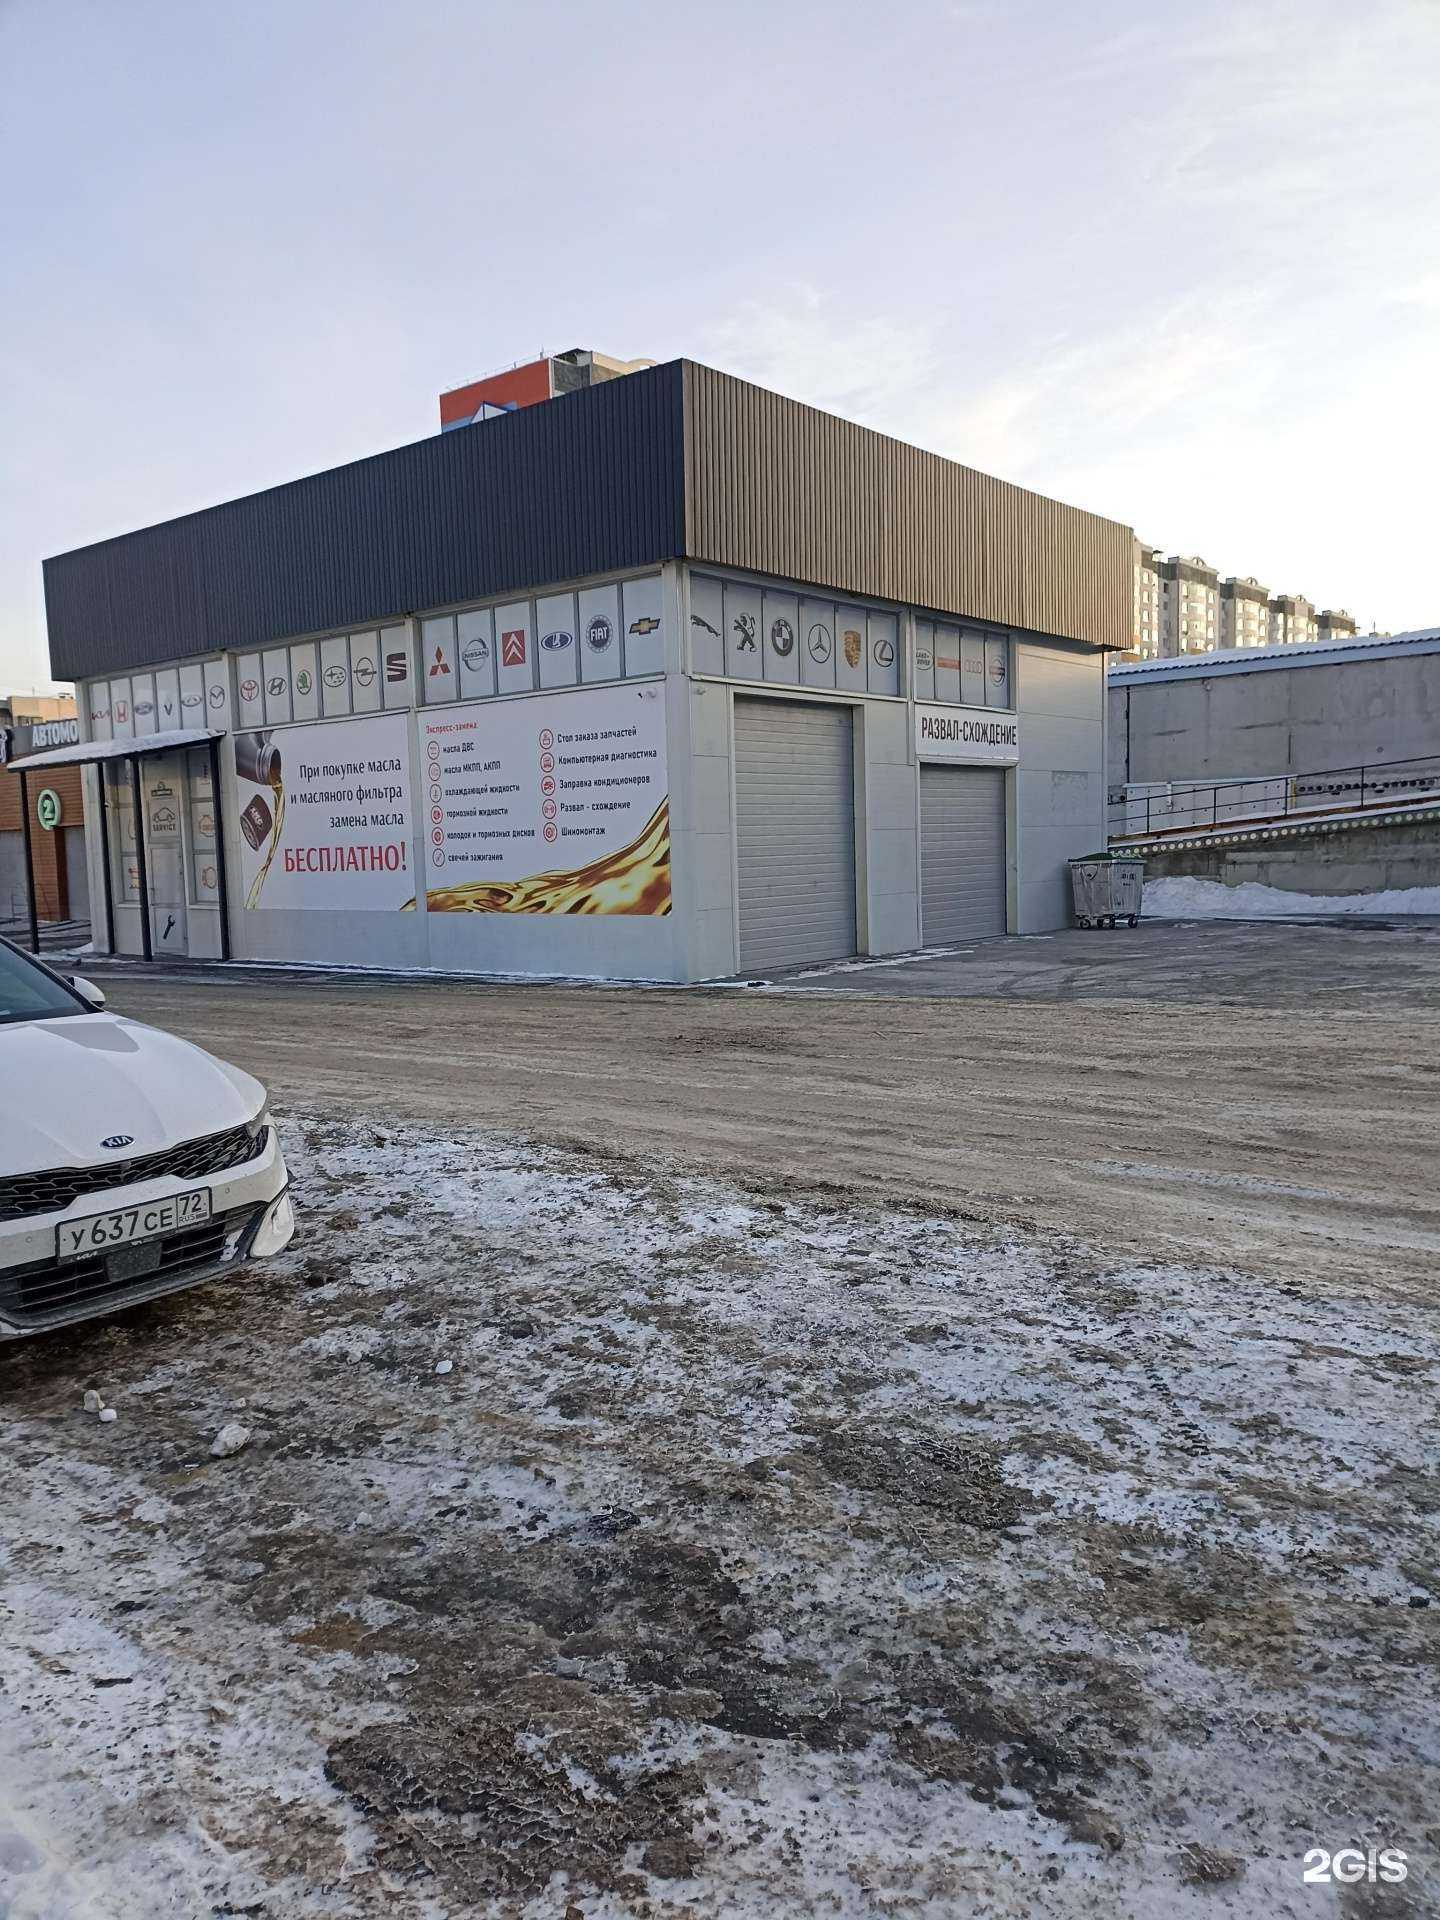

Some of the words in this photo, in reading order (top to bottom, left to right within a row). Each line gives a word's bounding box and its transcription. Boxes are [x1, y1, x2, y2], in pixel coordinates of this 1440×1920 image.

[590, 626, 607, 641] FIAT
[463, 650, 488, 661] NISSAN
[426, 722, 477, 734] Экспресс-замена
[575, 733, 599, 742] заказа
[600, 725, 637, 740] запчастей
[921, 717, 1017, 746] РАЗВАЛ-СХОЖДЕНИЕ
[443, 744, 461, 754] масла
[461, 742, 475, 754] ДВС
[558, 754, 609, 766] Компьютерная
[610, 749, 657, 762] диагностика
[299, 765, 320, 783] При
[322, 762, 365, 780] покупке
[367, 758, 402, 773] масла
[444, 765, 461, 774] масла
[483, 760, 501, 771] АКПП
[559, 778, 591, 790] Заправка
[593, 775, 650, 788] кондиционеров
[290, 794, 297, 805] и
[299, 789, 353, 804] масляного
[356, 785, 403, 805] фильтра
[445, 784, 488, 796] охлаждающей
[489, 784, 520, 795] жидкости
[560, 803, 585, 812] Развал
[591, 800, 631, 812] схождение
[446, 807, 477, 819] тормозной
[478, 808, 509, 817] жидкости
[329, 815, 368, 828] замена
[370, 812, 405, 826] масла
[152, 823, 176, 831] SERVICE
[561, 827, 606, 837] Шиномонтаж
[447, 831, 471, 840] колодок
[478, 830, 510, 840] тормозных
[512, 829, 536, 839] дисков
[284, 841, 407, 872] БЕСПЛАТНО!
[448, 852, 469, 862] свечей
[470, 853, 503, 862] зажигания
[106, 1136, 132, 1148] KIA
[179, 1193, 202, 1216] 72
[178, 1213, 196, 1224] RUS
